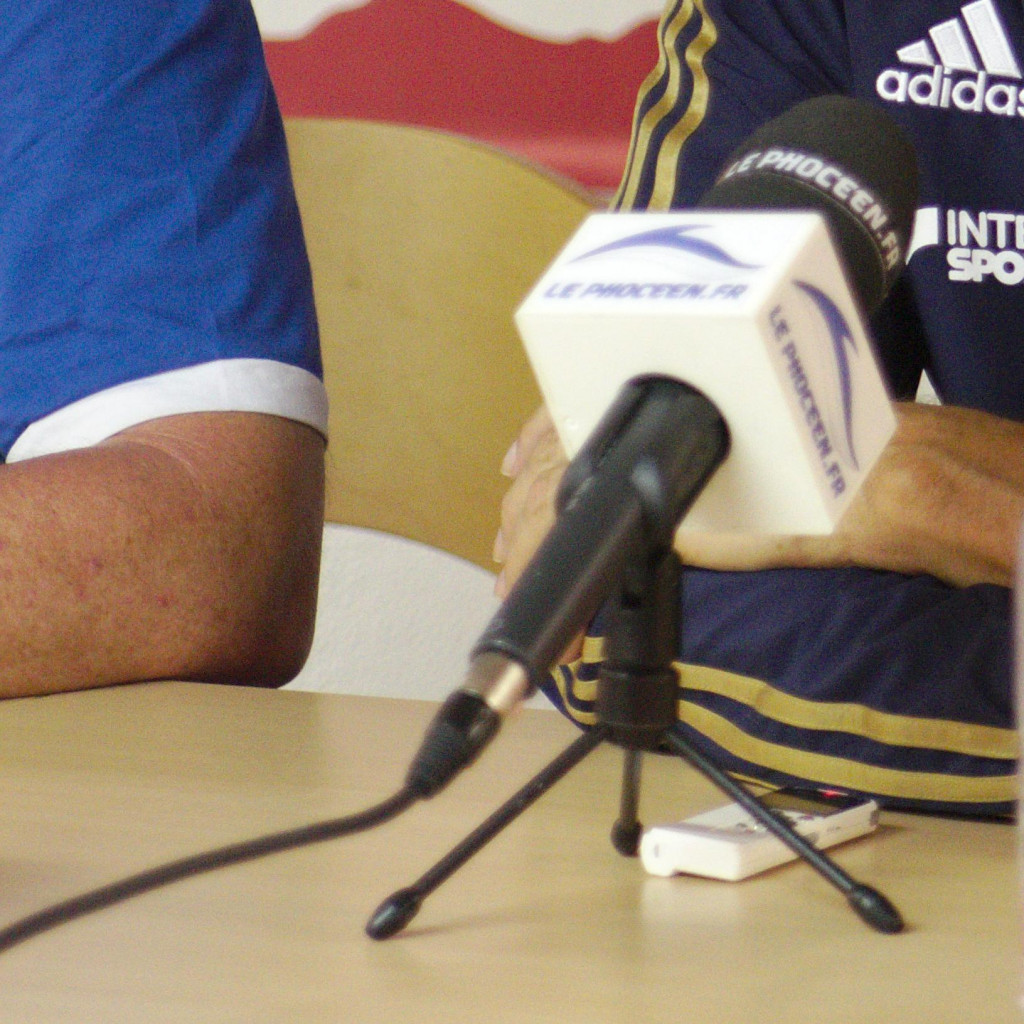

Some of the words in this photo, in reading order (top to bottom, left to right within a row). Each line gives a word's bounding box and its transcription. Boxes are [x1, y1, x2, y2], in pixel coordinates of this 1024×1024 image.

[720, 152, 761, 183] LE
[757, 150, 901, 271] PHOCEEN.FR
[543, 282, 583, 299] LE
[579, 282, 749, 300] PHOCEEN.FR
[769, 305, 790, 342] LE
[782, 340, 846, 499] PHOCEEN.FR
